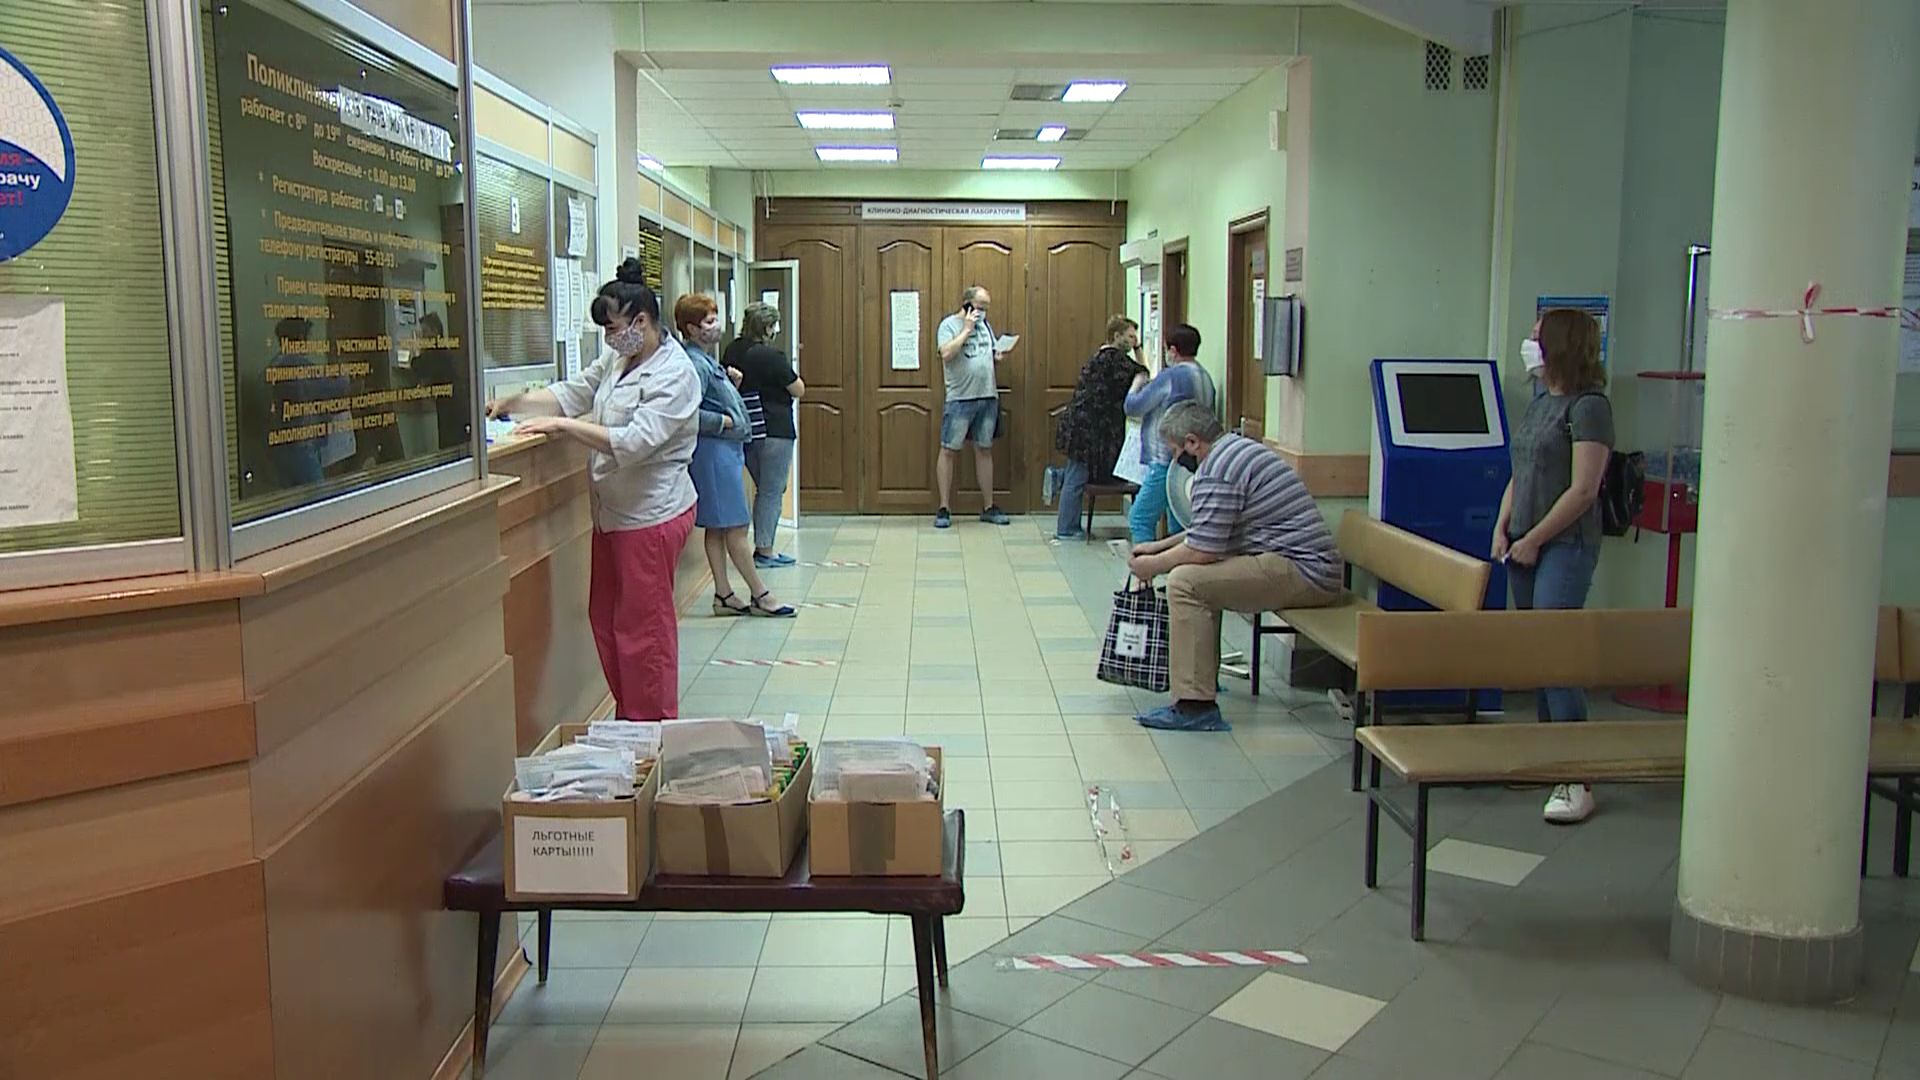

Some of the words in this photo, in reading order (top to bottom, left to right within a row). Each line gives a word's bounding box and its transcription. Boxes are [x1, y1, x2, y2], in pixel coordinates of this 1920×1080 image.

[240, 97, 285, 124] работает
[272, 175, 328, 205] Регистратура
[970, 207, 1020, 215] ЛАБОРАТОРИЯ
[532, 831, 595, 842] ЛЬГОТНЫЕ
